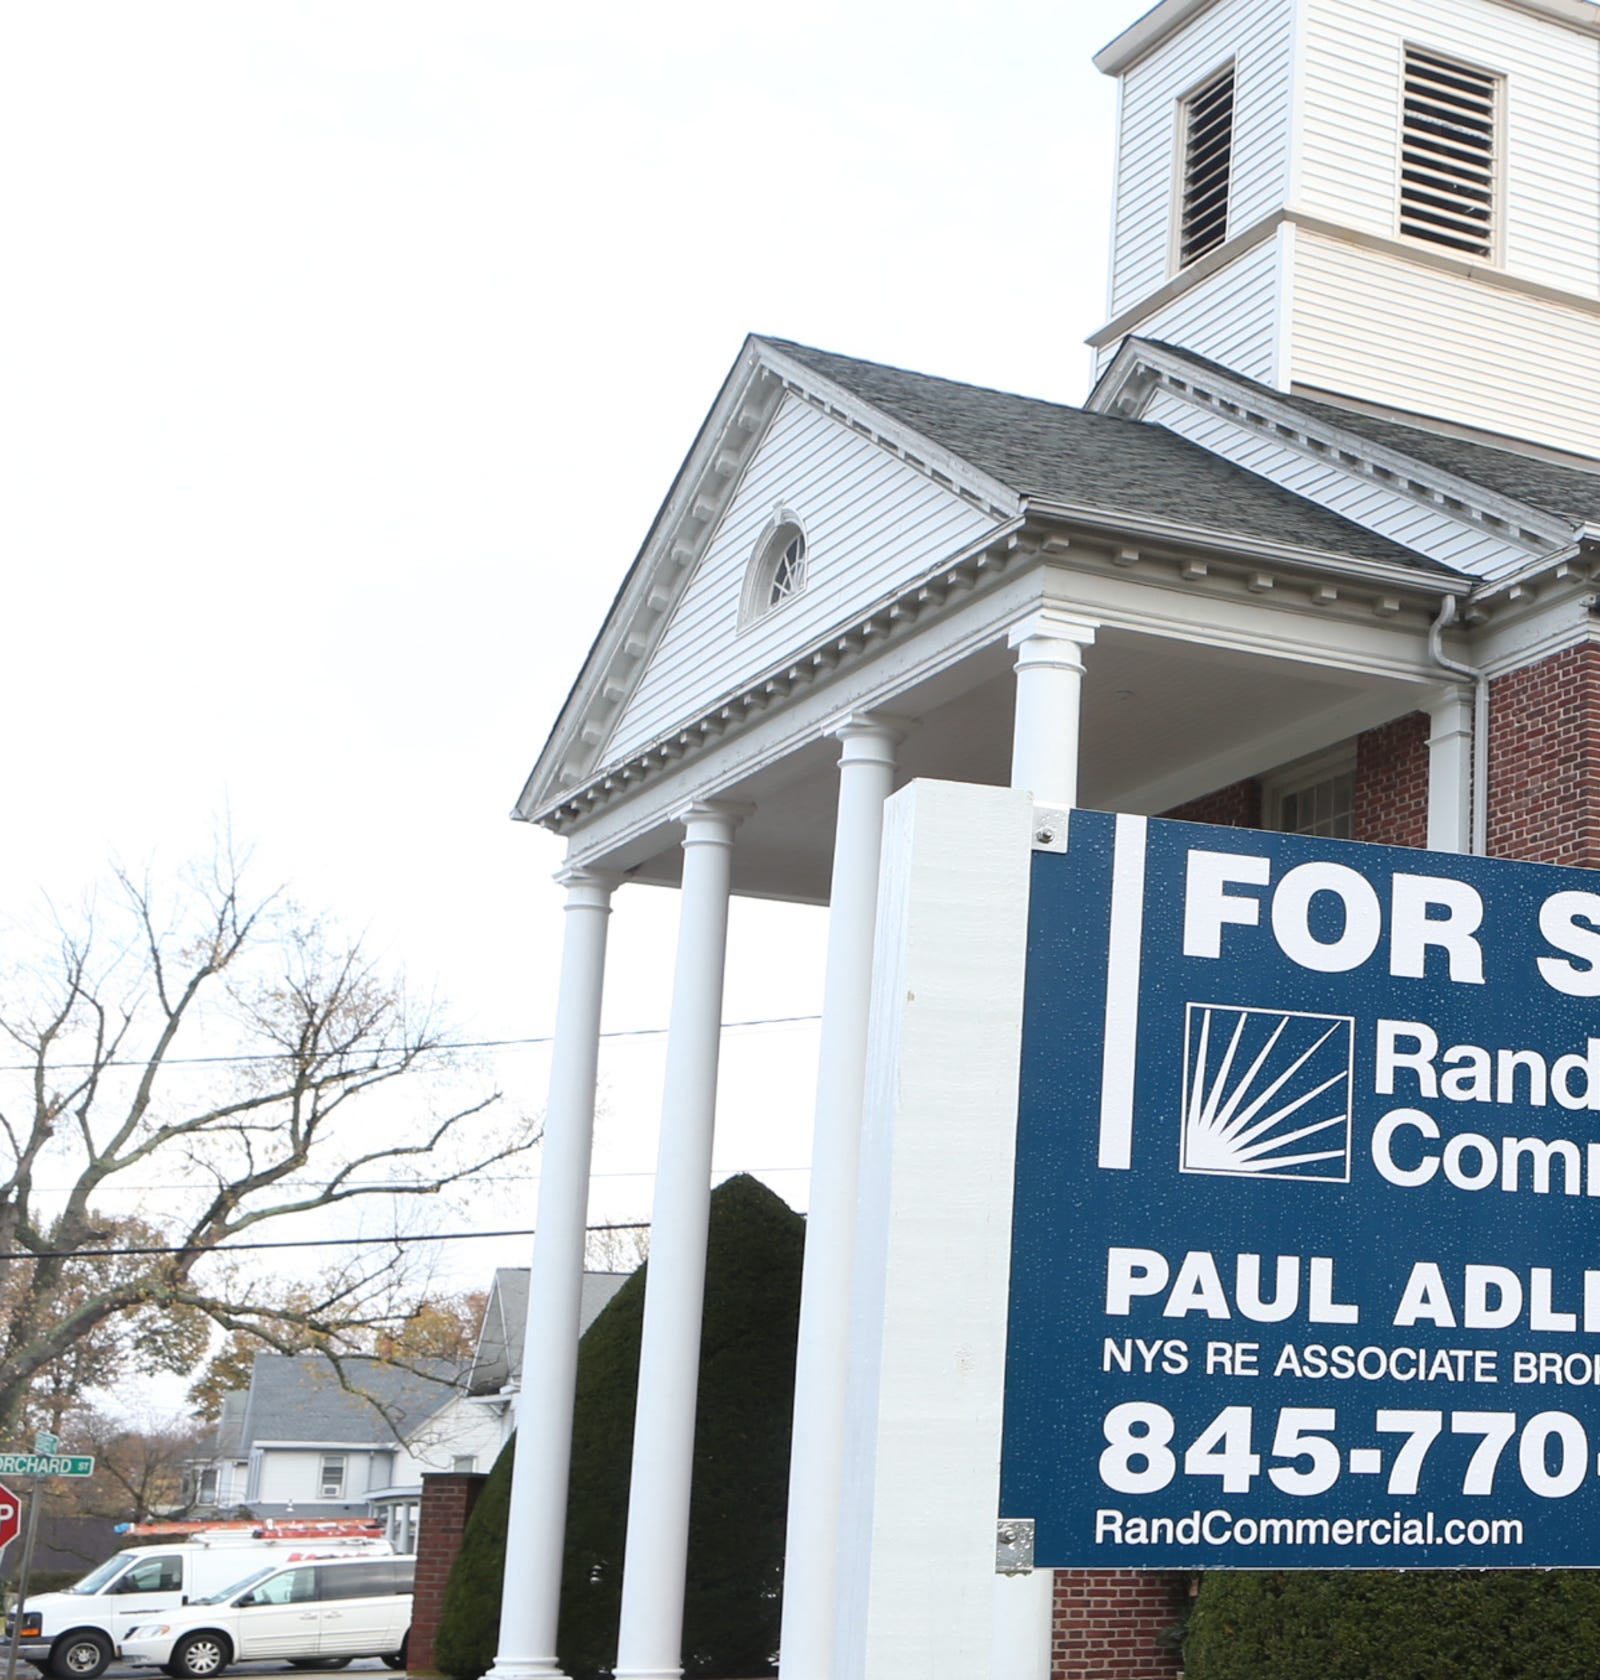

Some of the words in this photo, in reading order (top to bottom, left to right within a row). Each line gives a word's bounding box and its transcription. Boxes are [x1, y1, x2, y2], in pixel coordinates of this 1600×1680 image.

[1183, 849, 1486, 985] FOR
[1105, 1247, 1359, 1324] PAUL
[1103, 1337, 1189, 1375] NYS
[1206, 1341, 1260, 1376] RE
[1273, 1344, 1498, 1383] ASSOCIATE
[78, 1461, 89, 1471] ST
[1095, 1509, 1523, 1545] RandCommercial.com
